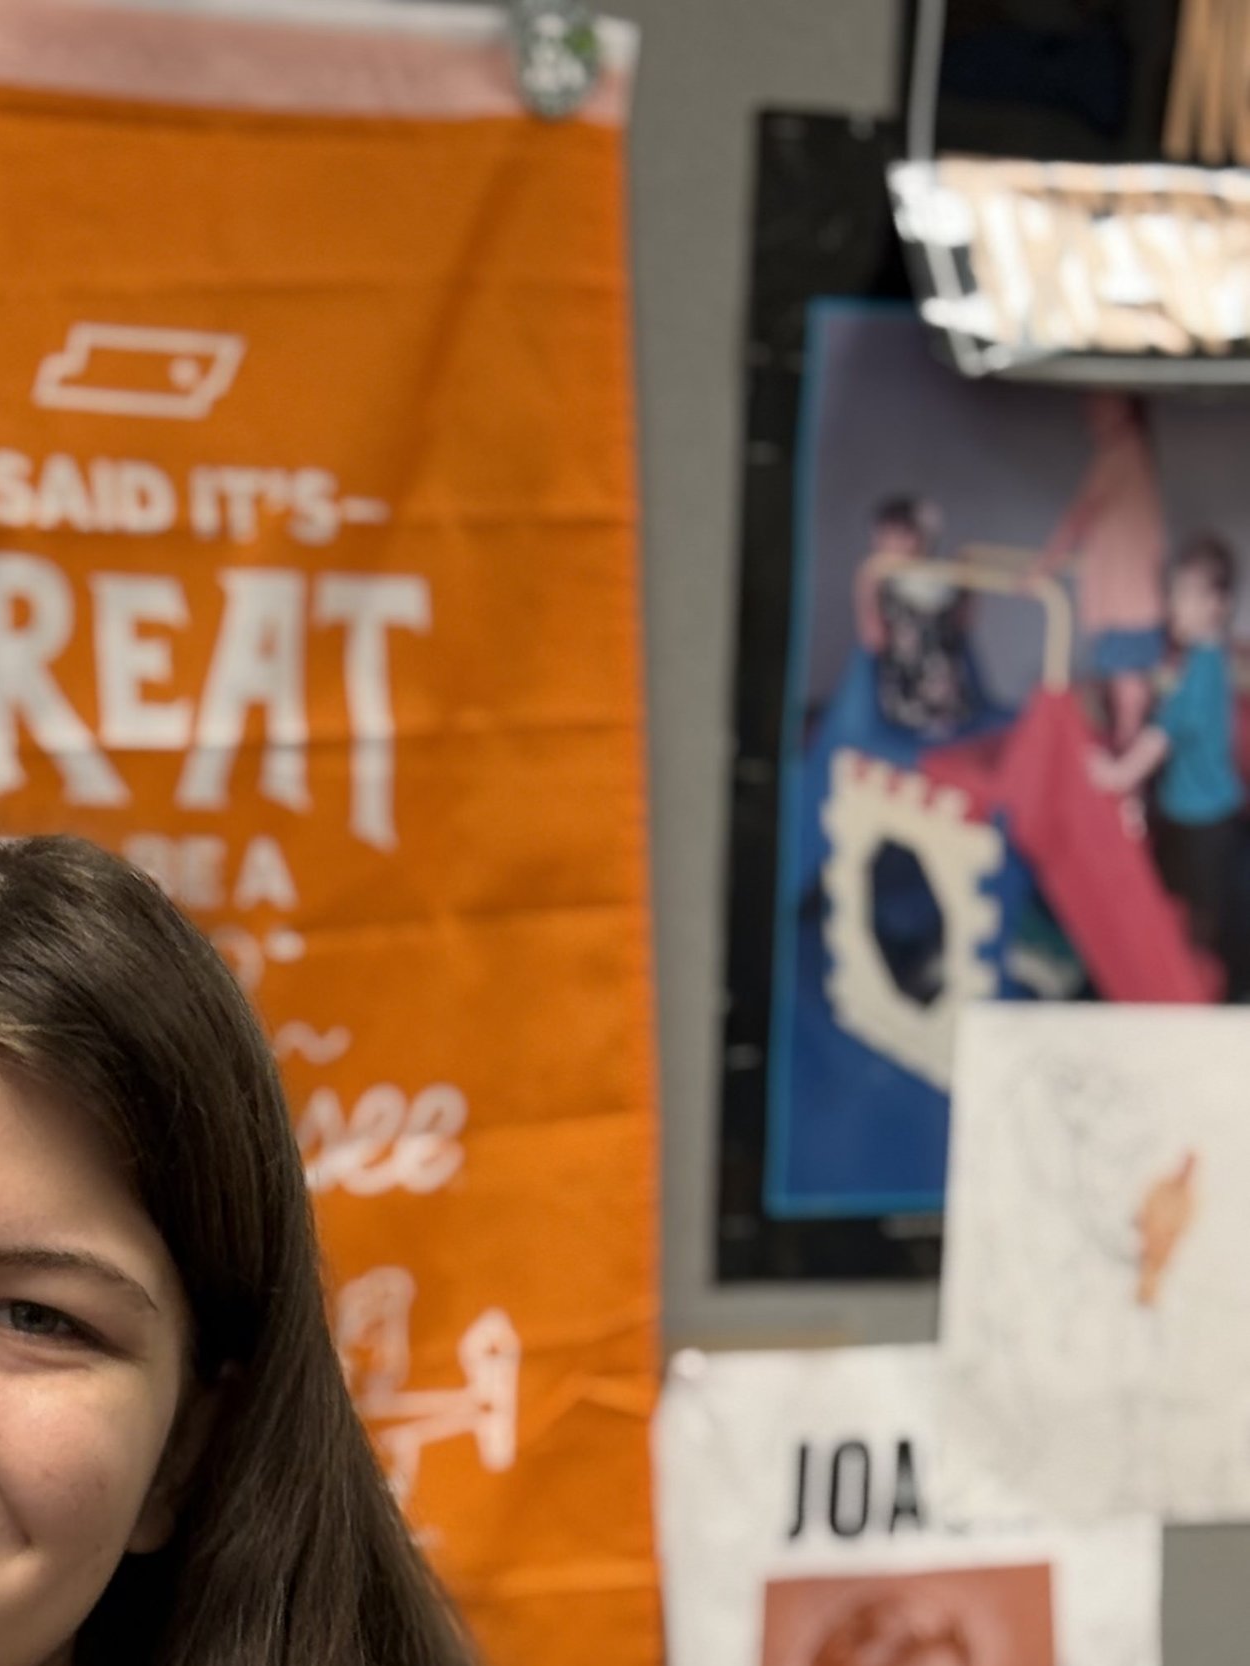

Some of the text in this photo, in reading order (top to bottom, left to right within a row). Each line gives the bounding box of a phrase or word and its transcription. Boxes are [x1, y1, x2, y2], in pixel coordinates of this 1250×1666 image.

[190, 464, 340, 543] IT'S
[234, 834, 299, 911] A
[786, 1438, 926, 1541] JOA
